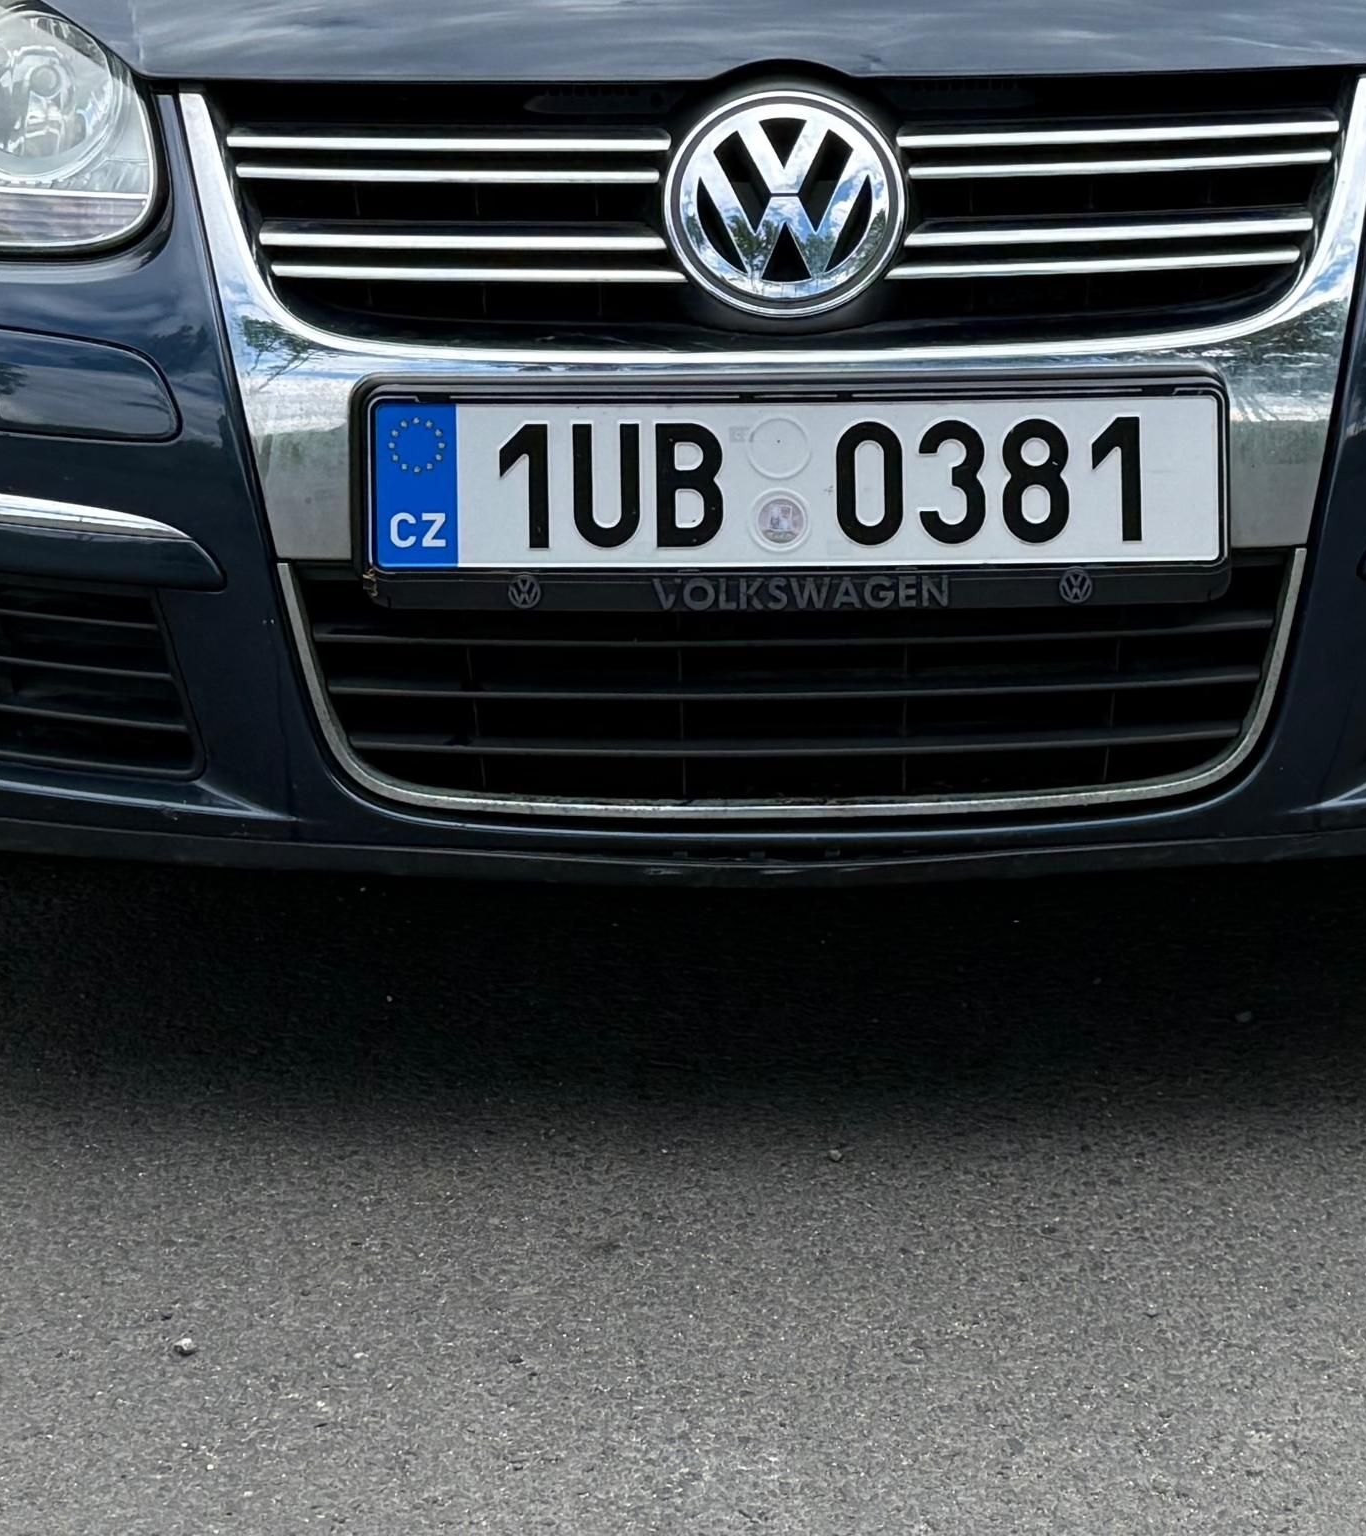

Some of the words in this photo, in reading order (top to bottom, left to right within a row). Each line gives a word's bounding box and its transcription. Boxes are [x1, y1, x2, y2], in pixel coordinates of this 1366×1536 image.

[680, 102, 890, 300] VW
[498, 422, 725, 550] 1UB
[834, 415, 1143, 547] 0381
[389, 512, 447, 548] CZ
[507, 573, 541, 609] VW
[651, 574, 951, 611] VOLKSWAGEN
[1059, 568, 1092, 603] VW
